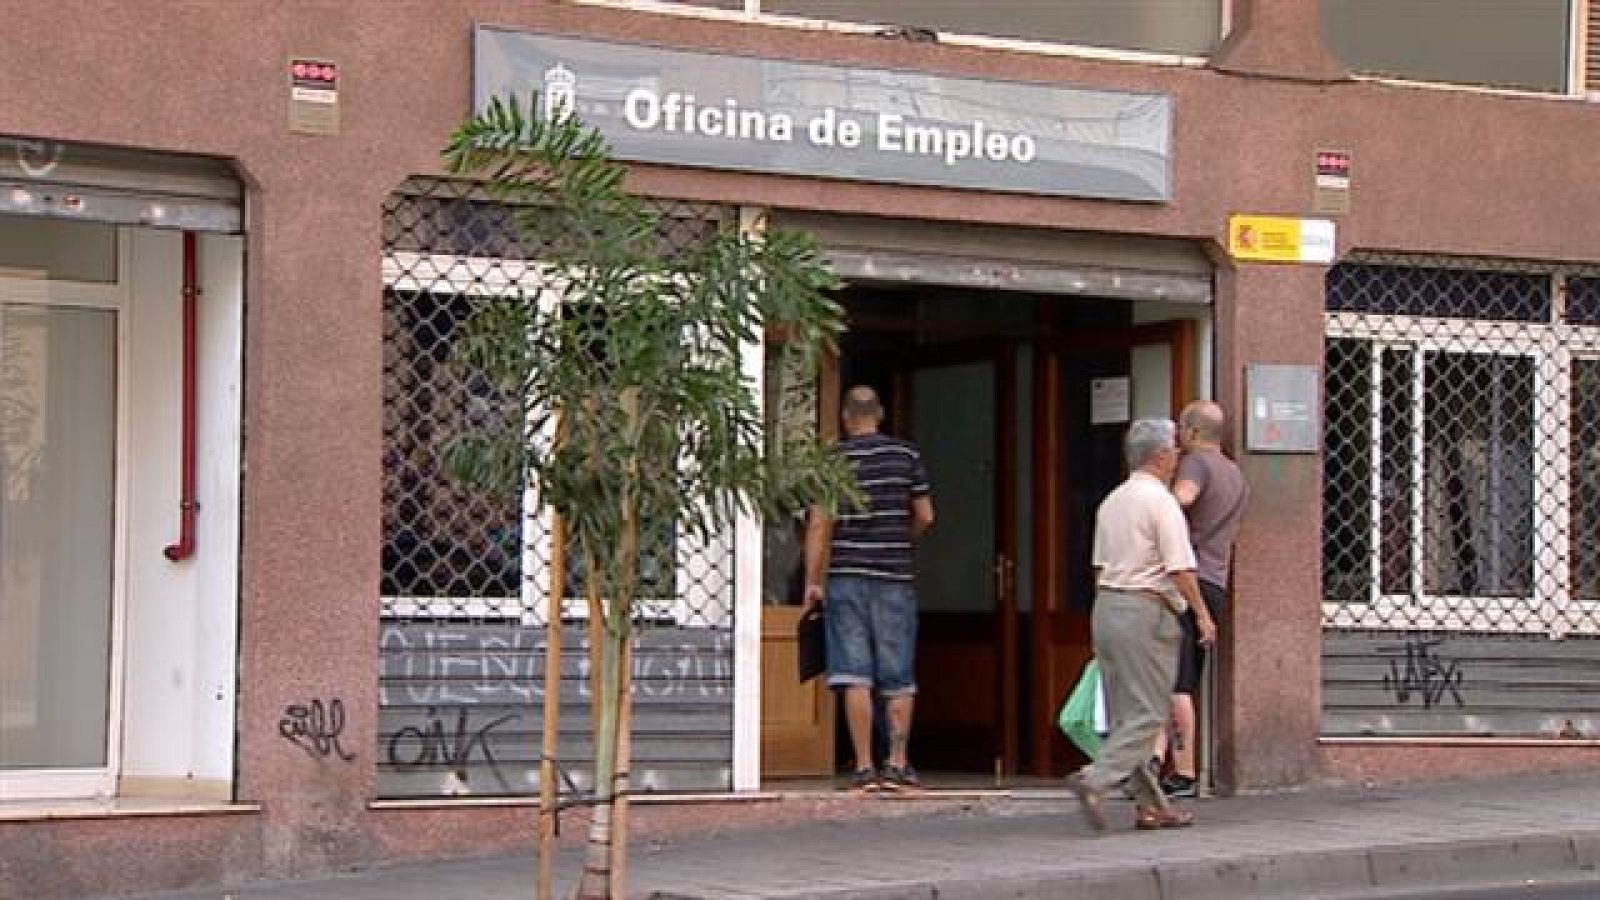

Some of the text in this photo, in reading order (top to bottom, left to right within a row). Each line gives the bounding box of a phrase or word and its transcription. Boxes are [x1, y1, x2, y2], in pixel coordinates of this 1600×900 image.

[623, 87, 1036, 165] Oficina de Empleo
